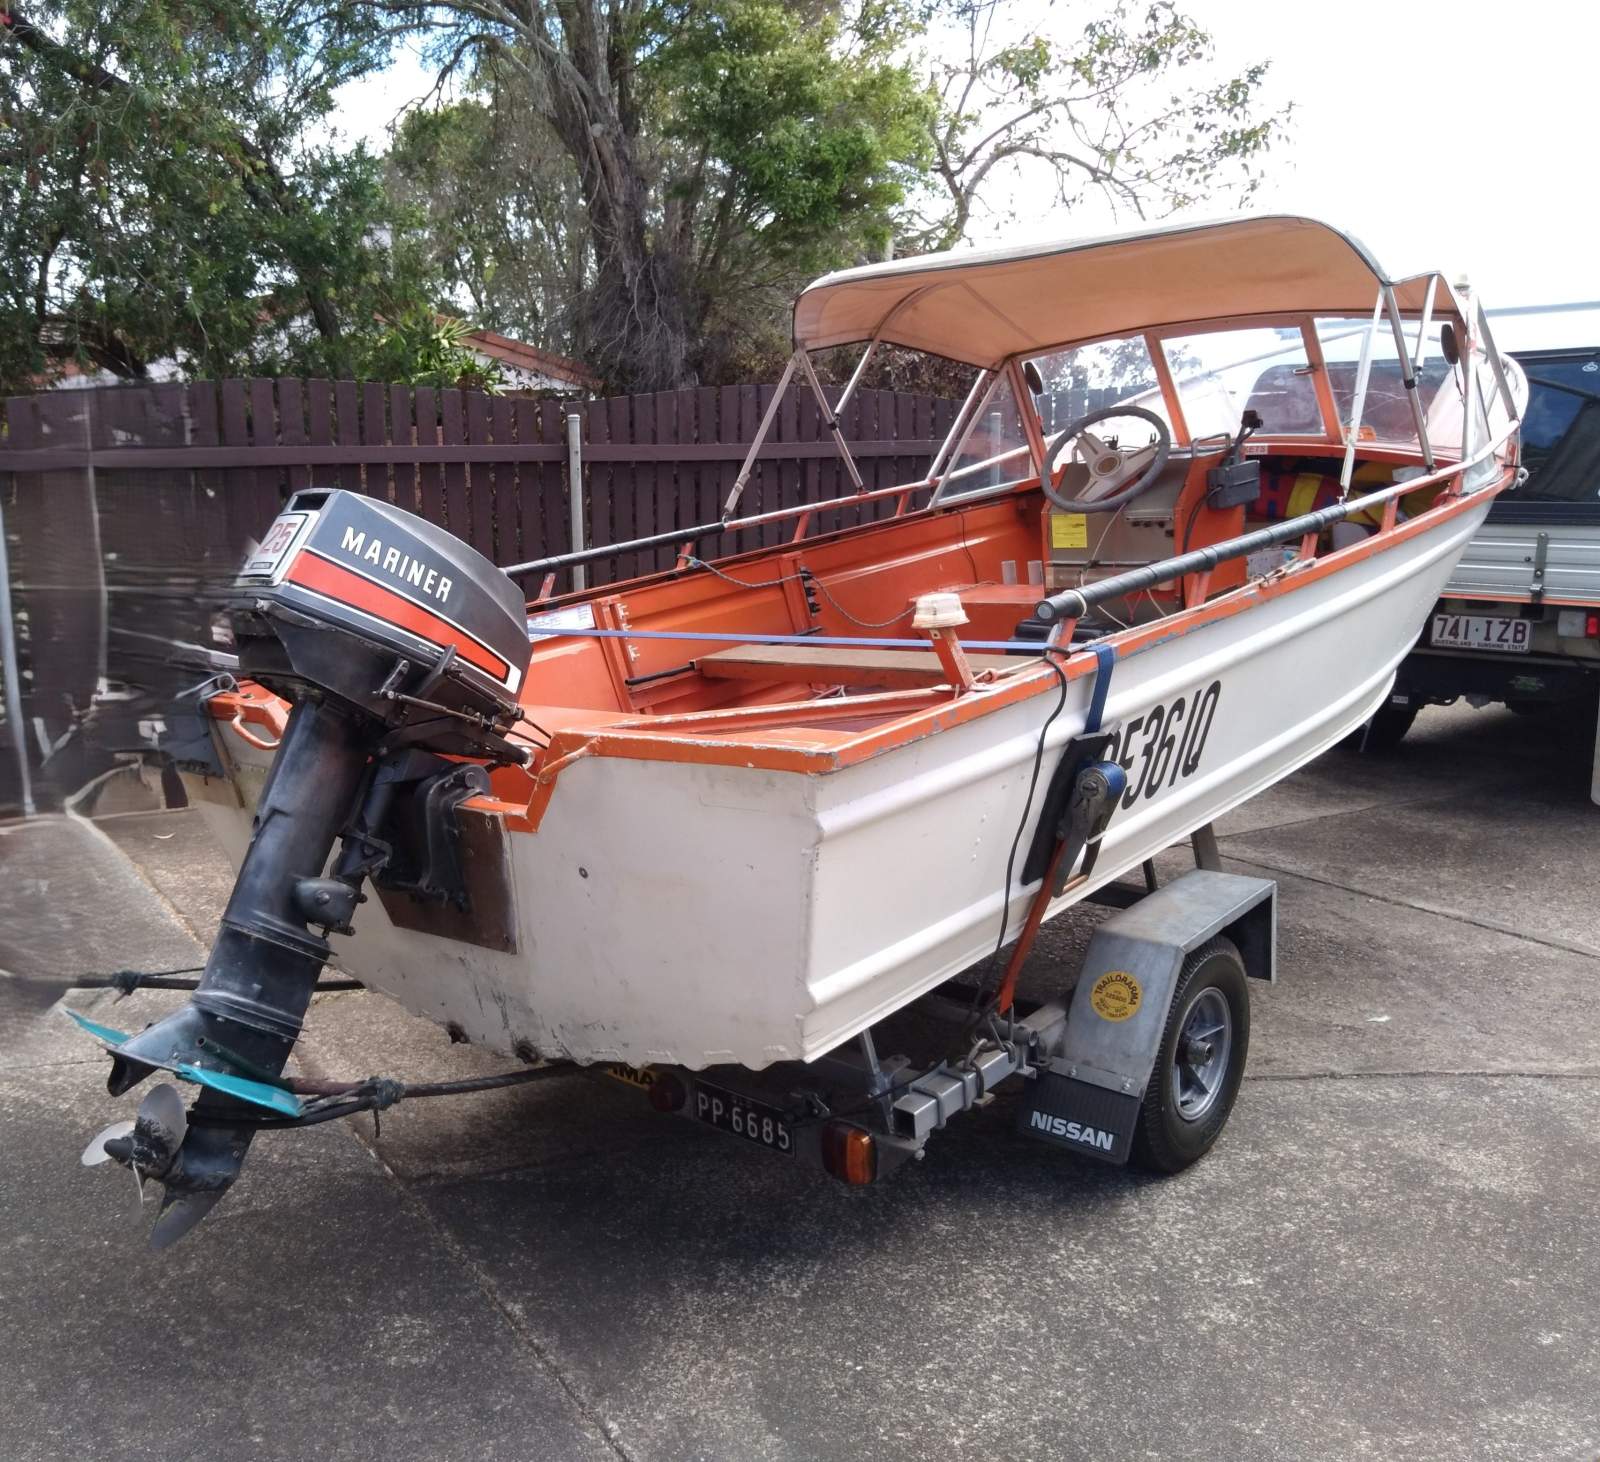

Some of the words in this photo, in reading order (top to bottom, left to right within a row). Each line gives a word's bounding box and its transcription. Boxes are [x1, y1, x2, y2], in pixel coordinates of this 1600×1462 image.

[259, 523, 297, 553] 25
[341, 526, 453, 604] MARINER
[1030, 1111, 1114, 1150] NISSAN
